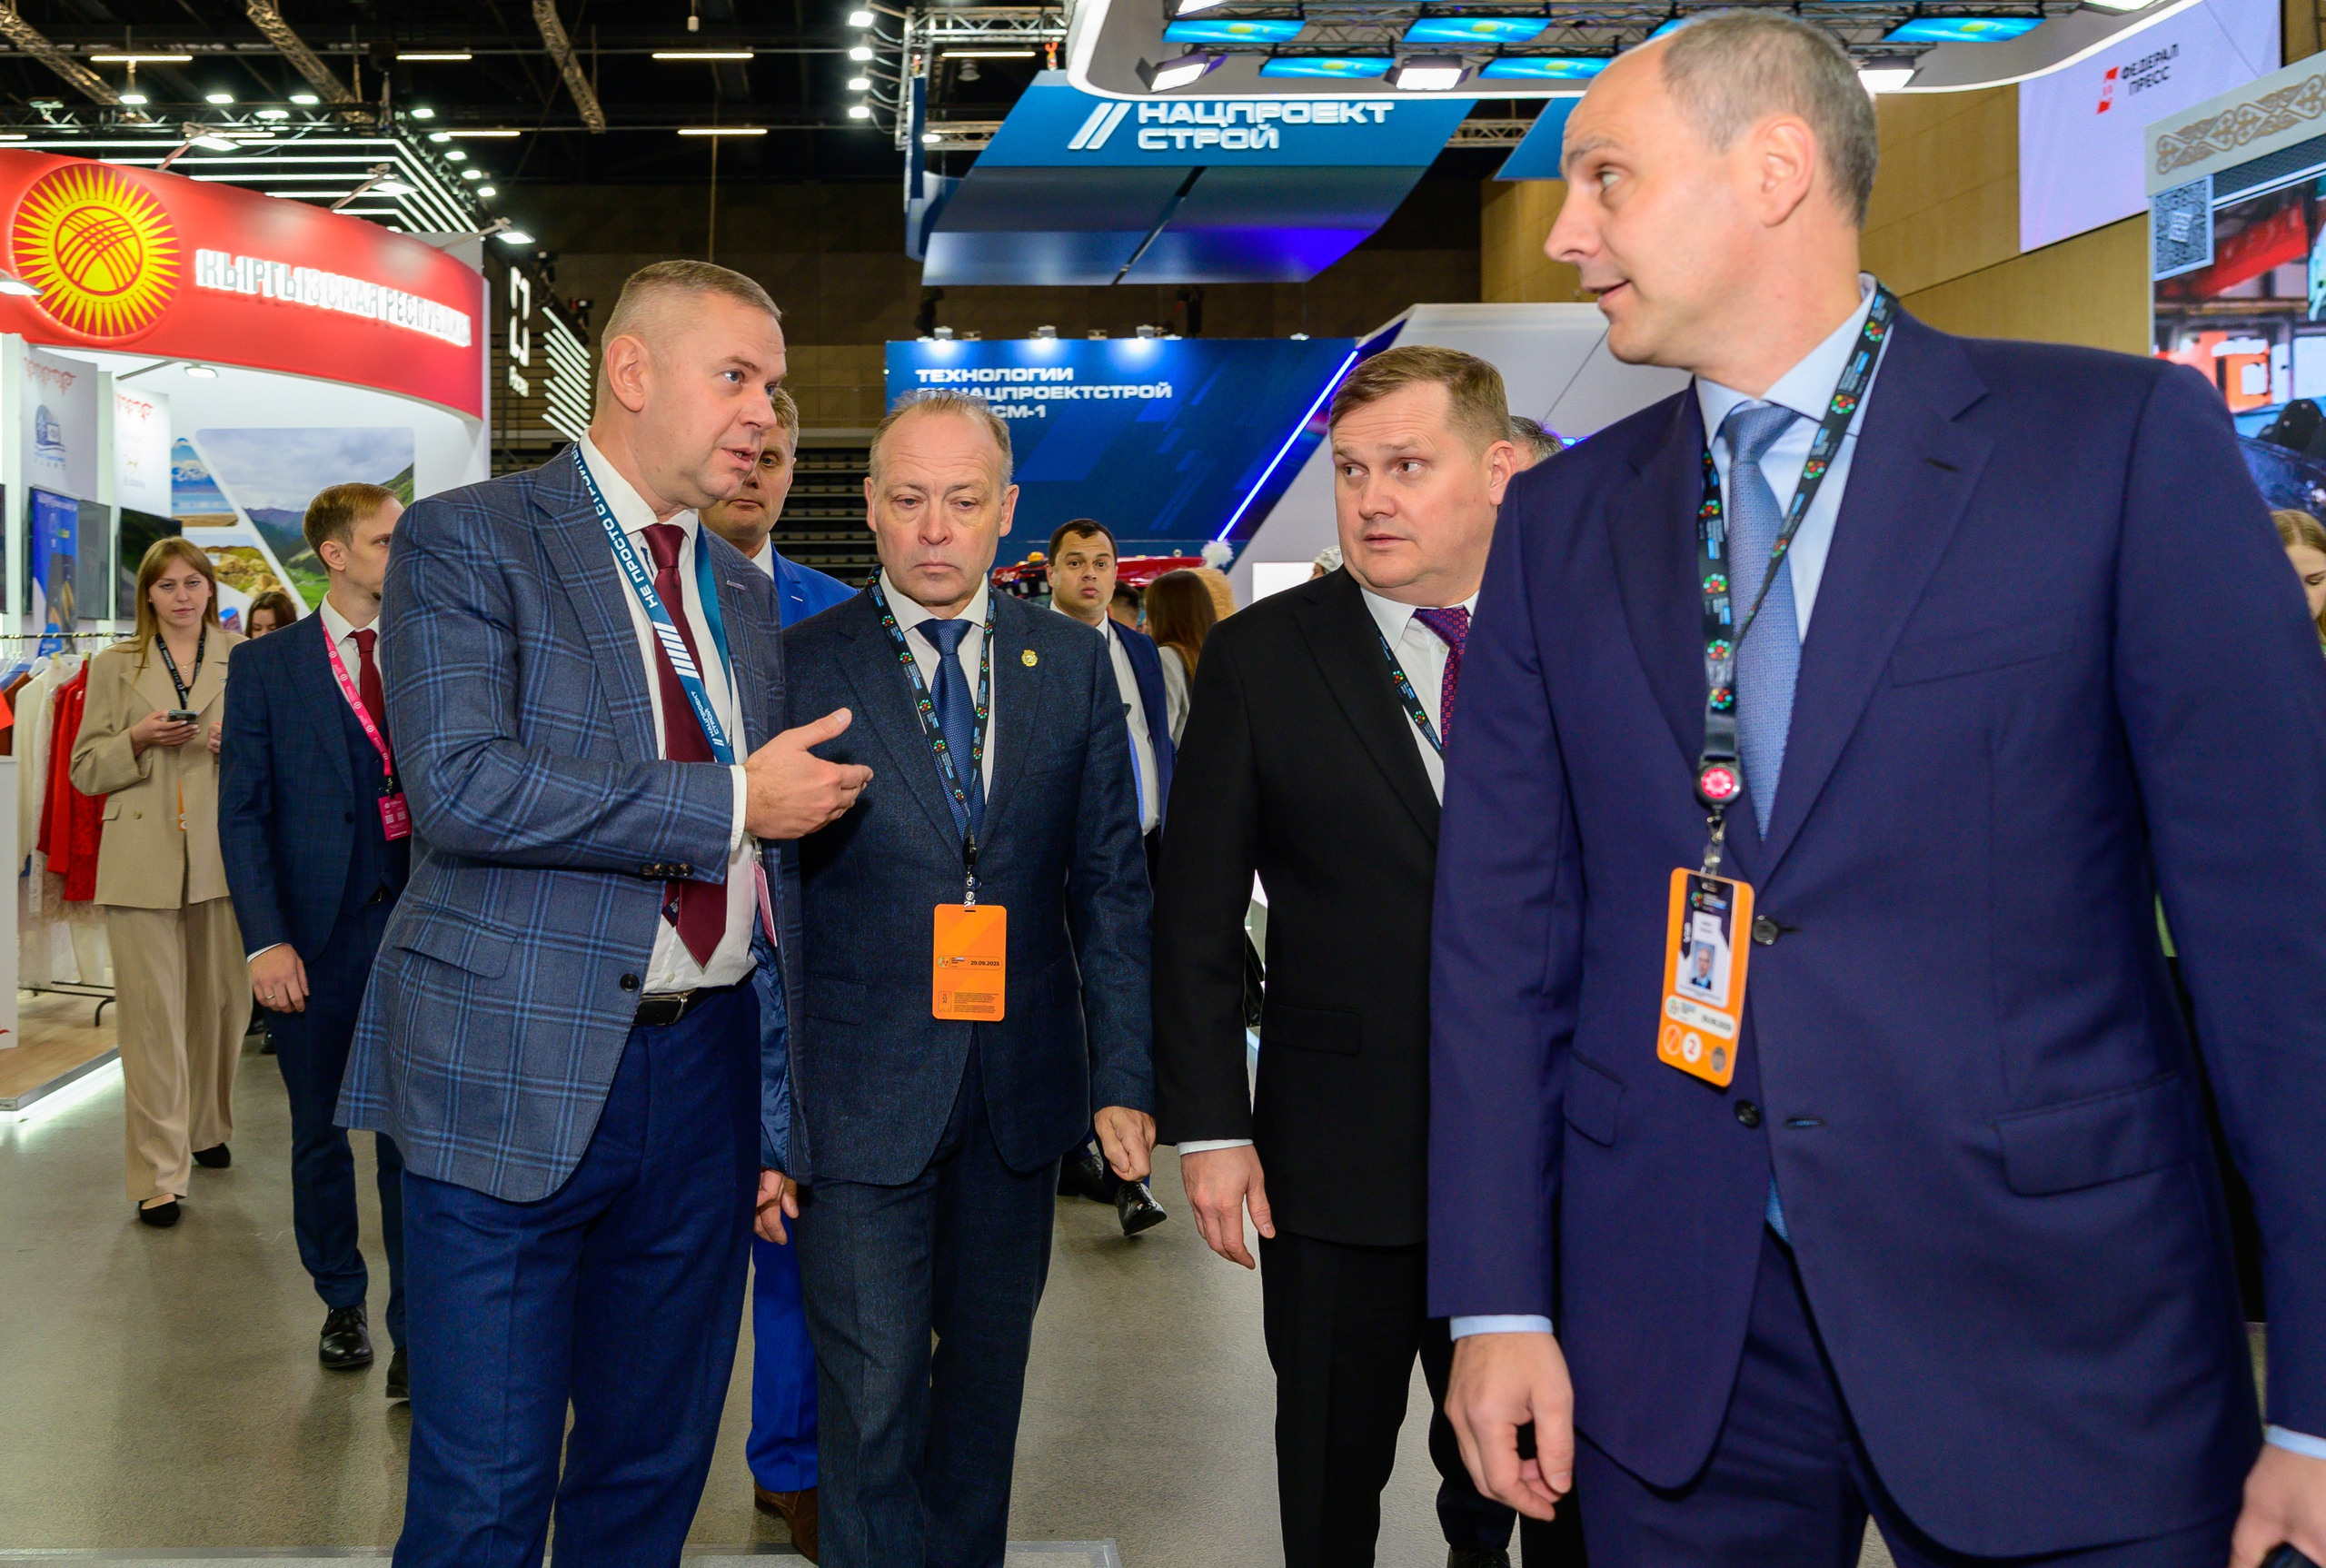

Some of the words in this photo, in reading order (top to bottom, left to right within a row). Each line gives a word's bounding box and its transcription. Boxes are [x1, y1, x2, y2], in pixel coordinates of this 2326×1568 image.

[2121, 43, 2179, 79] ФЕДЕРАЛ
[2129, 65, 2169, 95] ПРЕСС
[1138, 102, 1395, 128] НАЦПРОЕКТ
[1138, 123, 1279, 150] СТРОЙ
[195, 248, 377, 319] КЫРГЫЗСКАЯ
[915, 367, 1074, 382] ТЕХНОЛОГИИ
[988, 404, 1046, 419] СМ-1
[602, 517, 645, 584] ПРОСТО
[640, 583, 659, 609] НЕ
[691, 690, 715, 738] НАЦПРОЕКТ
[1687, 1038, 1696, 1056] 2
